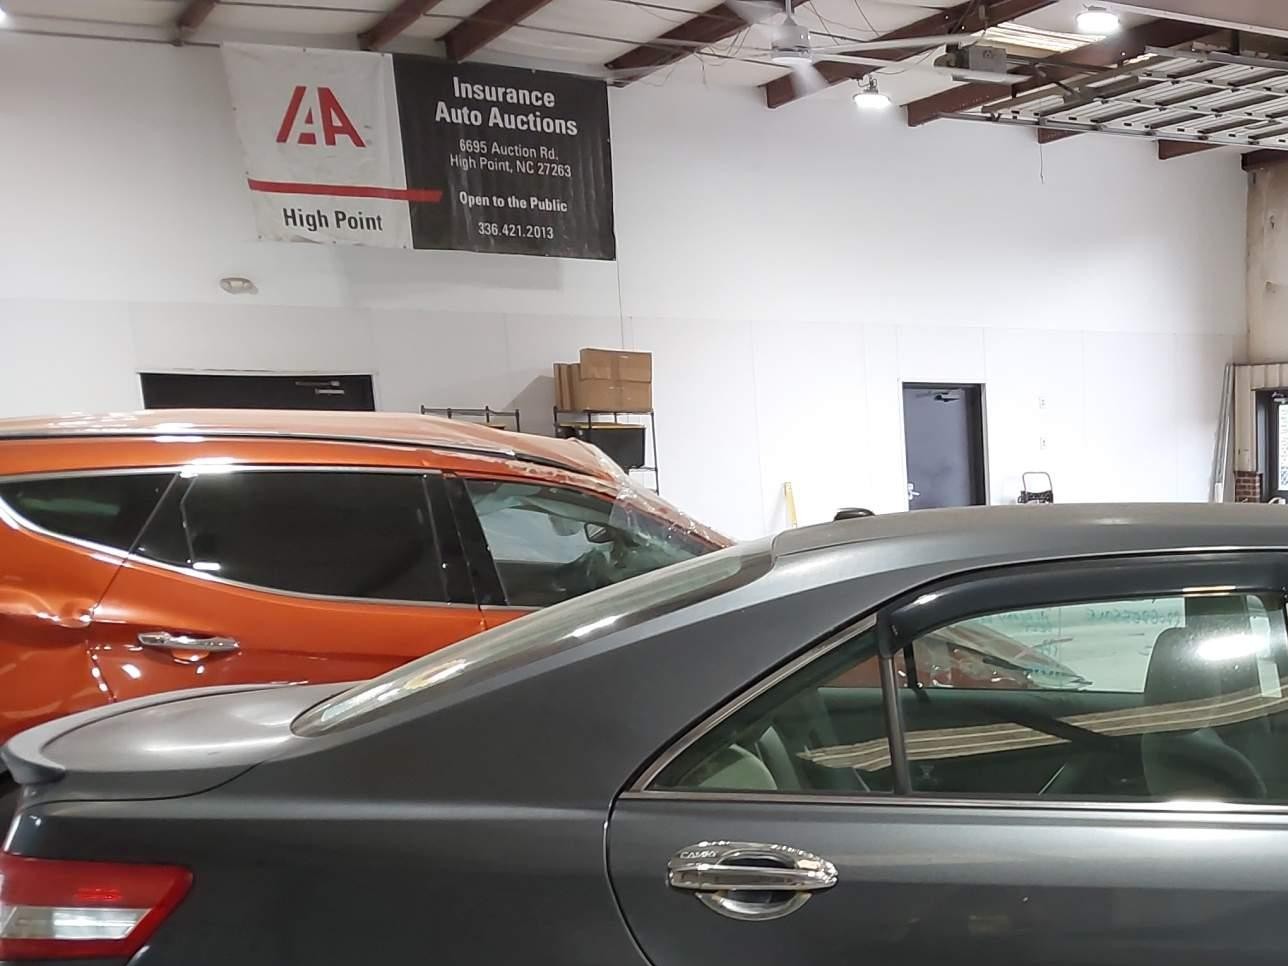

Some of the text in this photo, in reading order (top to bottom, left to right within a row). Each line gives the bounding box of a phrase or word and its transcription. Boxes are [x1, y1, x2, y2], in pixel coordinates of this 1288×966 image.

[453, 76, 555, 107] Insurance
[435, 101, 578, 136] Auto Auctions
[459, 139, 559, 160] 6695 Auction Rd.
[450, 154, 572, 177] High Point, NC 27263
[459, 191, 568, 212] Open to the Public
[283, 207, 383, 232] High Point
[478, 222, 554, 239] 336.421.2013
